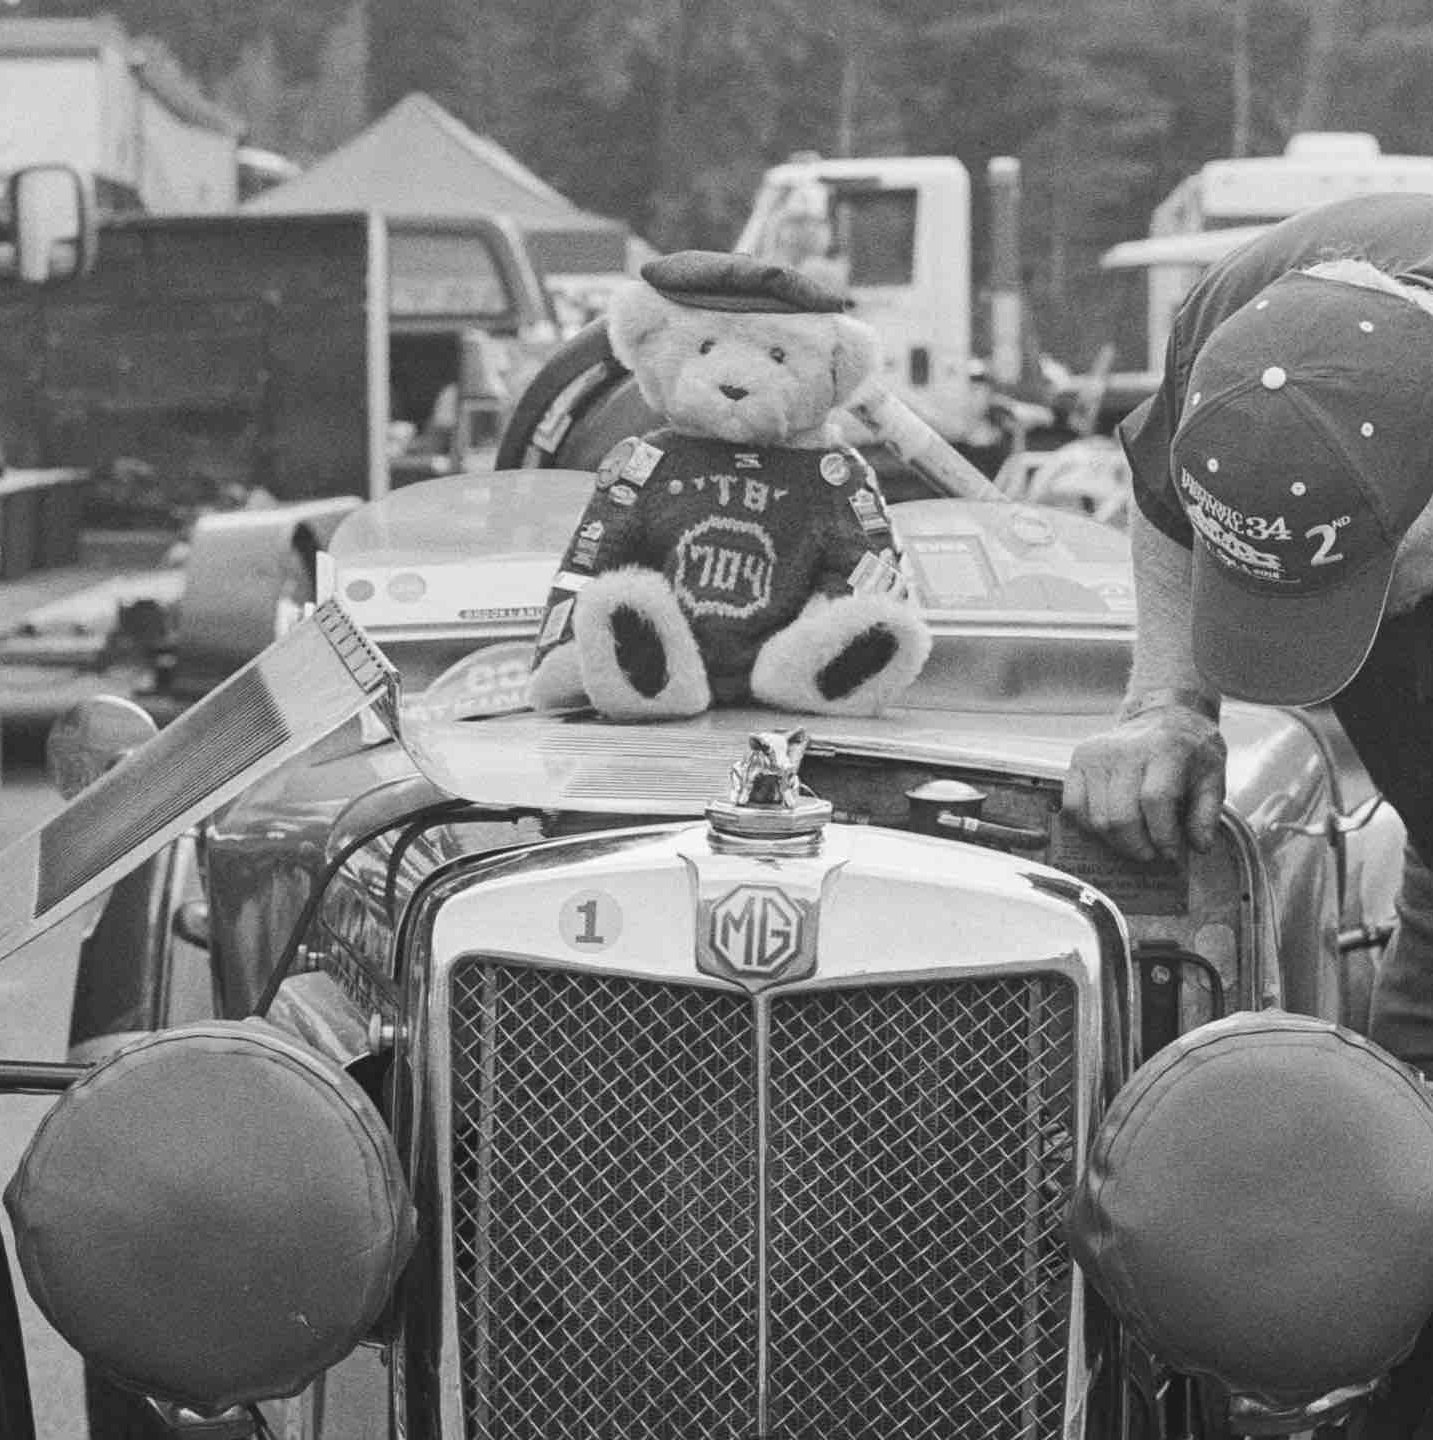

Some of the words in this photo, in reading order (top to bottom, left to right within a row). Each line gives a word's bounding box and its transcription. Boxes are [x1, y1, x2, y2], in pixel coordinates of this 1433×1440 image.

[1246, 515, 1293, 541] 34
[690, 544, 765, 603] 704
[575, 900, 604, 944] 1
[719, 895, 793, 967] MG
